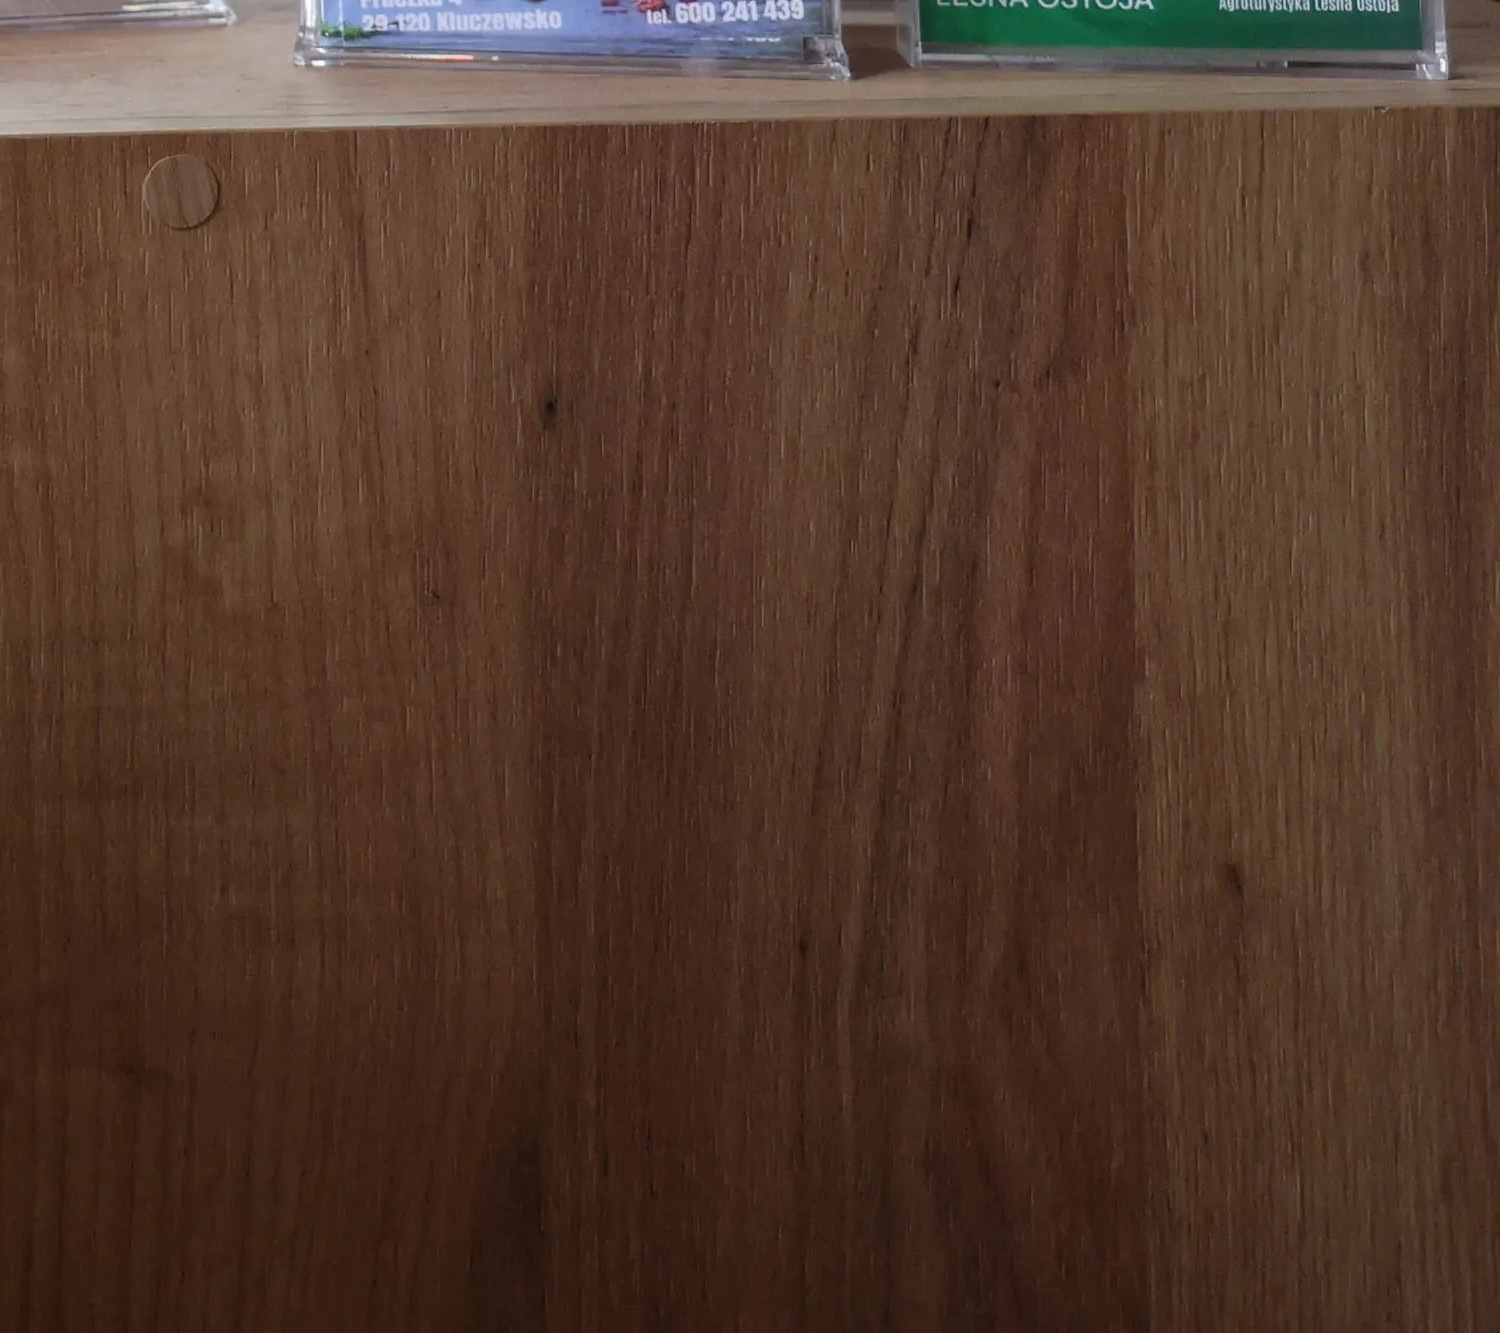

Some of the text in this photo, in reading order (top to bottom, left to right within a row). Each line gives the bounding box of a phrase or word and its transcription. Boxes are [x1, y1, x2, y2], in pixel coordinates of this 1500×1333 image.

[361, 10, 562, 32] 29-120 Kluczewsko
[675, 3, 716, 24] 600
[720, 2, 760, 23] 241
